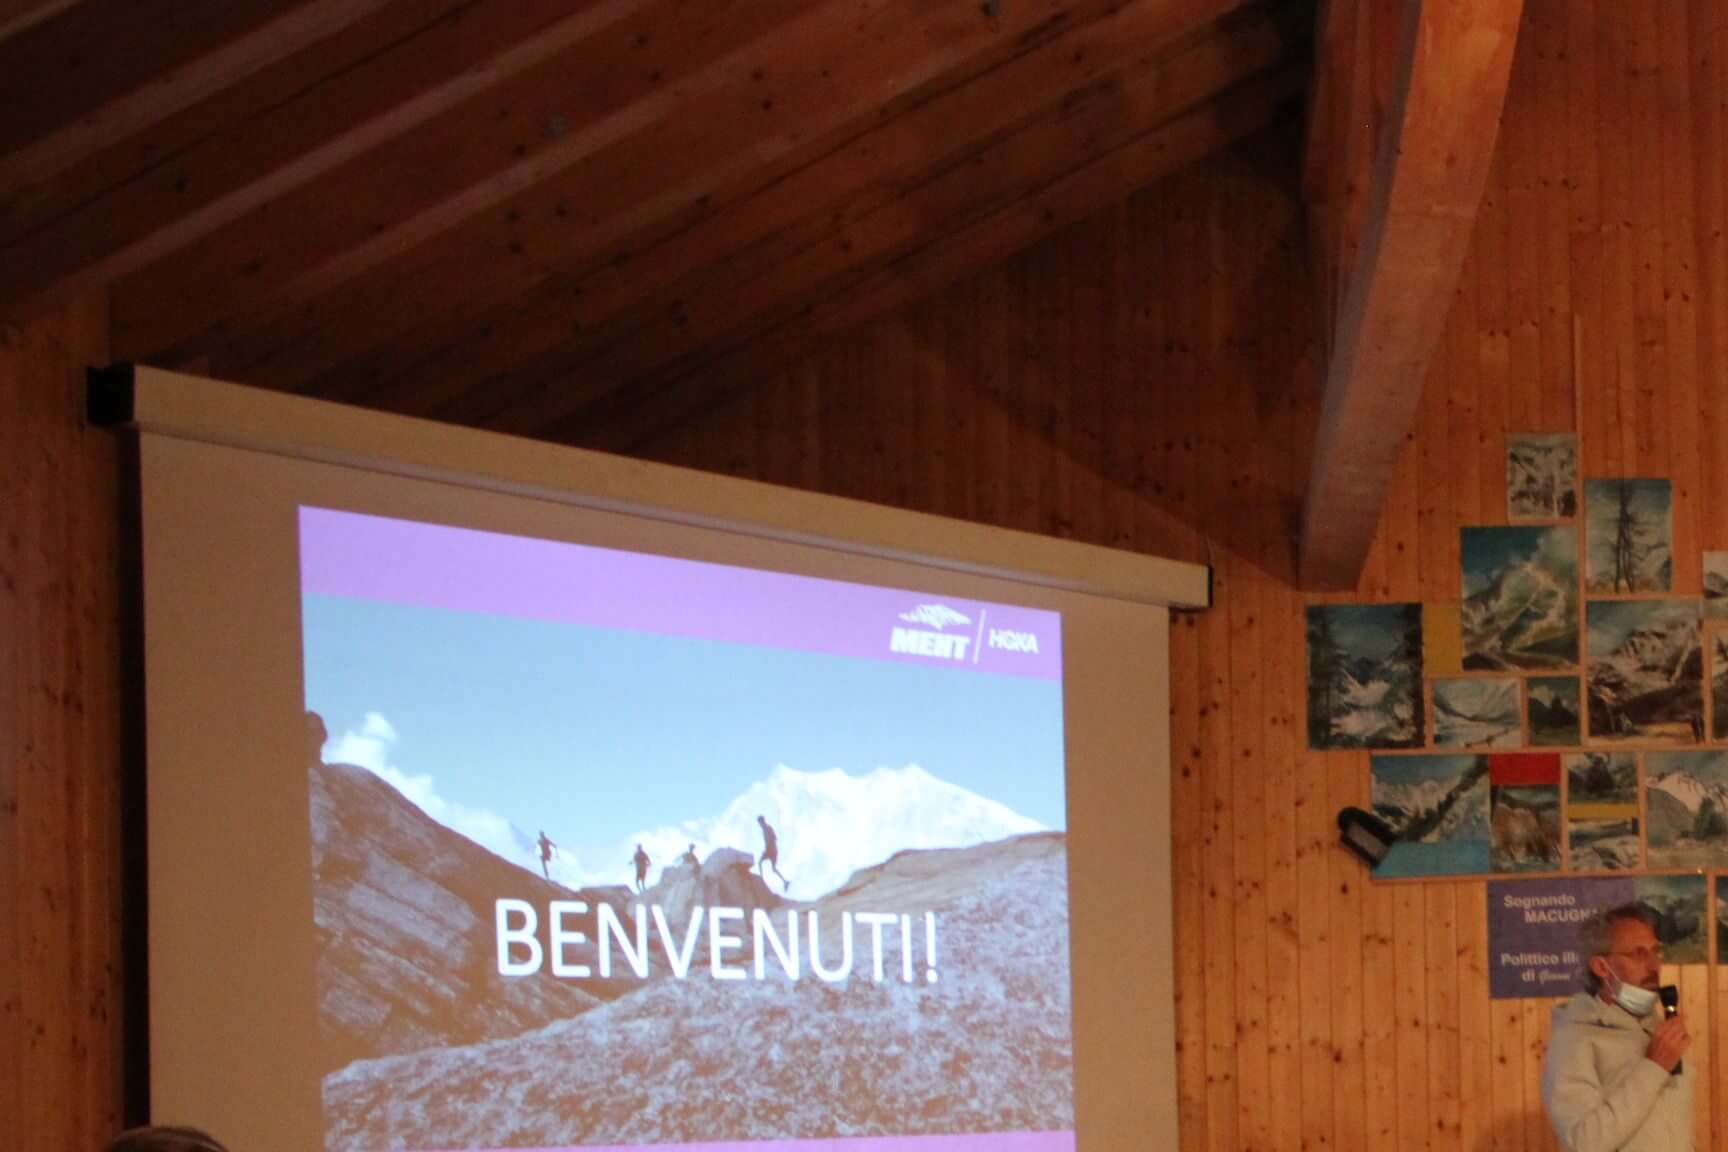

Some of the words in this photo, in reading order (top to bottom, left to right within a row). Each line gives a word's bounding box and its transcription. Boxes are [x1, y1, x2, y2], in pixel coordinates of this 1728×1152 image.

[988, 628, 1040, 655] HOKA
[1503, 894, 1577, 910] Sognando
[1524, 908, 1599, 923] MACUGN
[495, 898, 939, 984] BENVENUTI!
[1521, 969, 1536, 982] di
